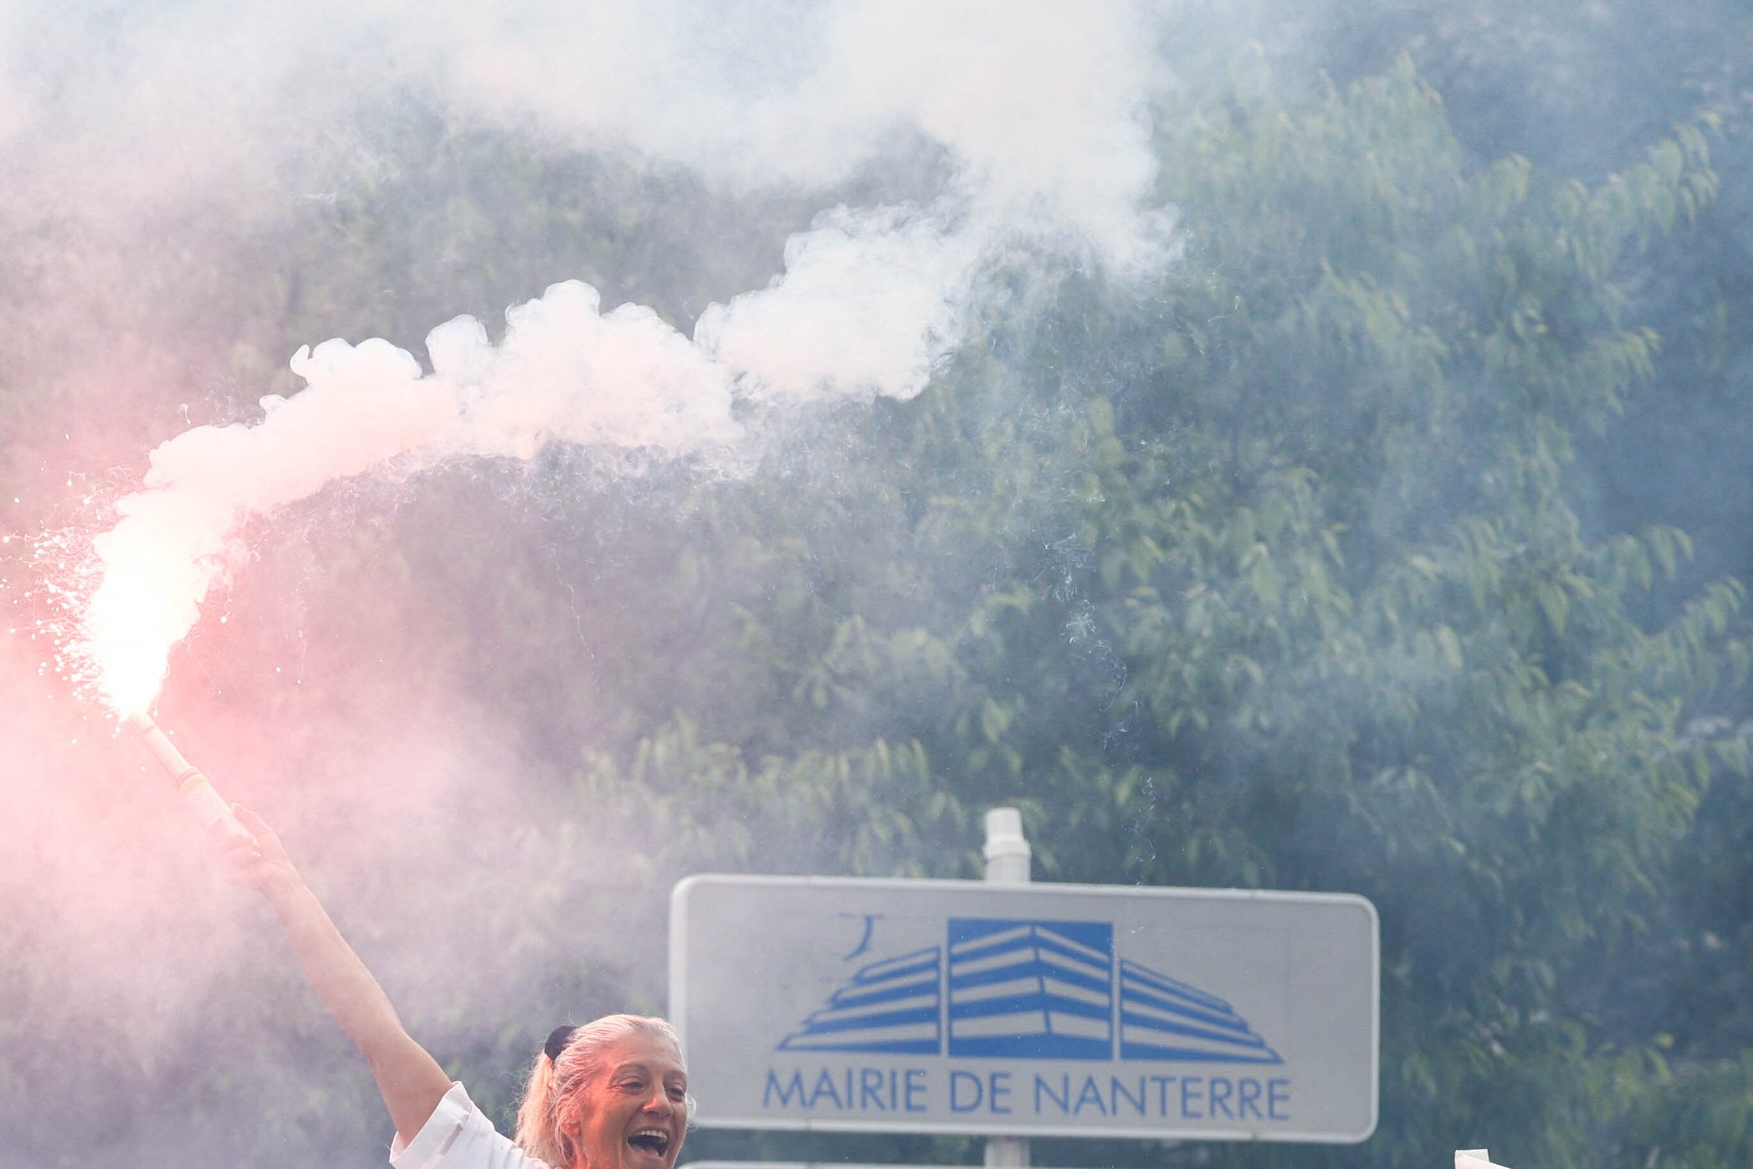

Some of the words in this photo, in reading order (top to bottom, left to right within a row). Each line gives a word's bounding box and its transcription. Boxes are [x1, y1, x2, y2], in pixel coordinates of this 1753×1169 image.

[763, 1067, 928, 1113] MAIRIE
[949, 1070, 1012, 1116] DE
[1033, 1073, 1292, 1121] NANTERRE
